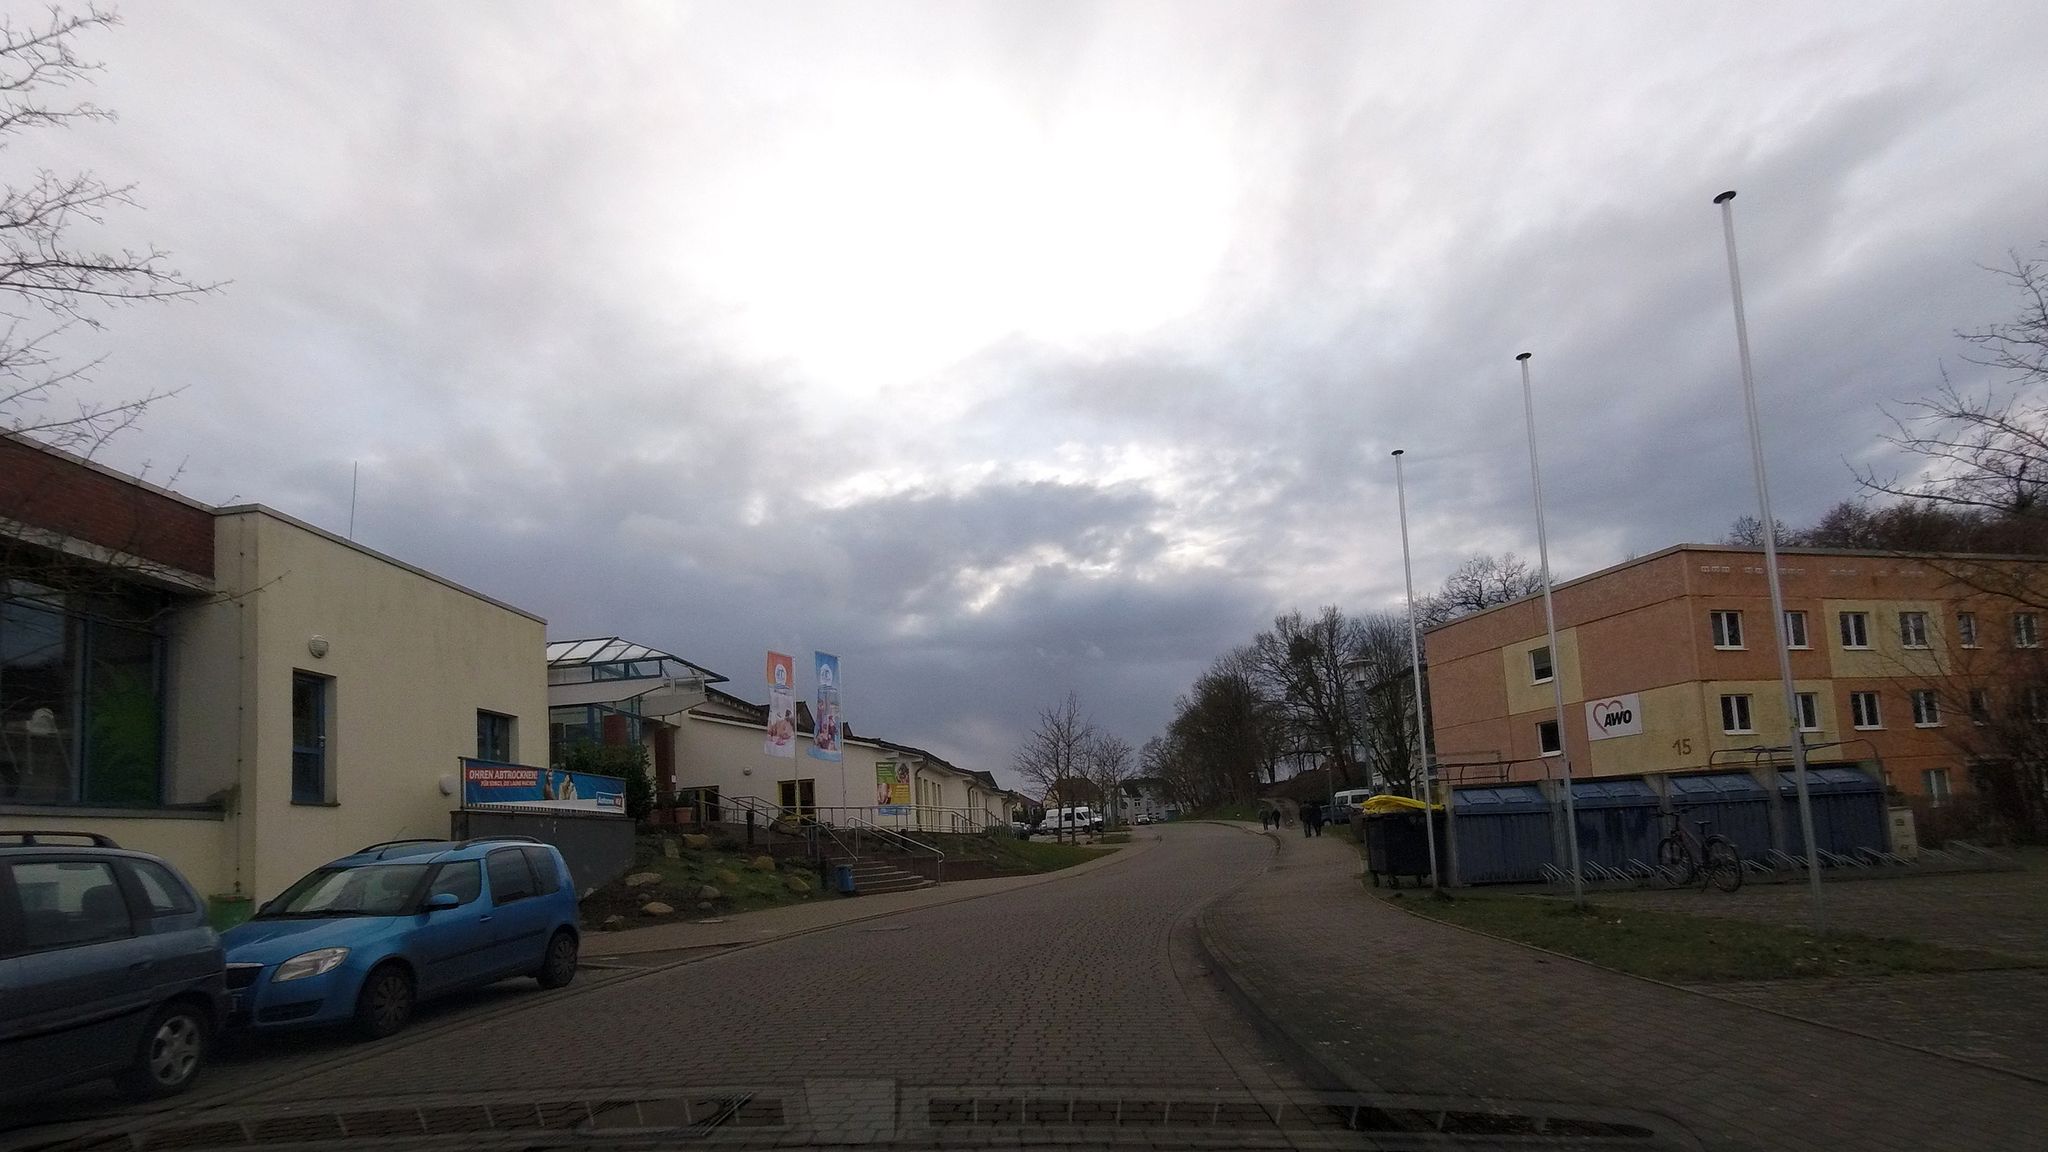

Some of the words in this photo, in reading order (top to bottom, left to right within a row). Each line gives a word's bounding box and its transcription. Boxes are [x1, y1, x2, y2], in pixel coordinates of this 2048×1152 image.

[1604, 709, 1632, 727] AWO
[1672, 738, 1692, 756] 15
[469, 769, 494, 780] OHREN
